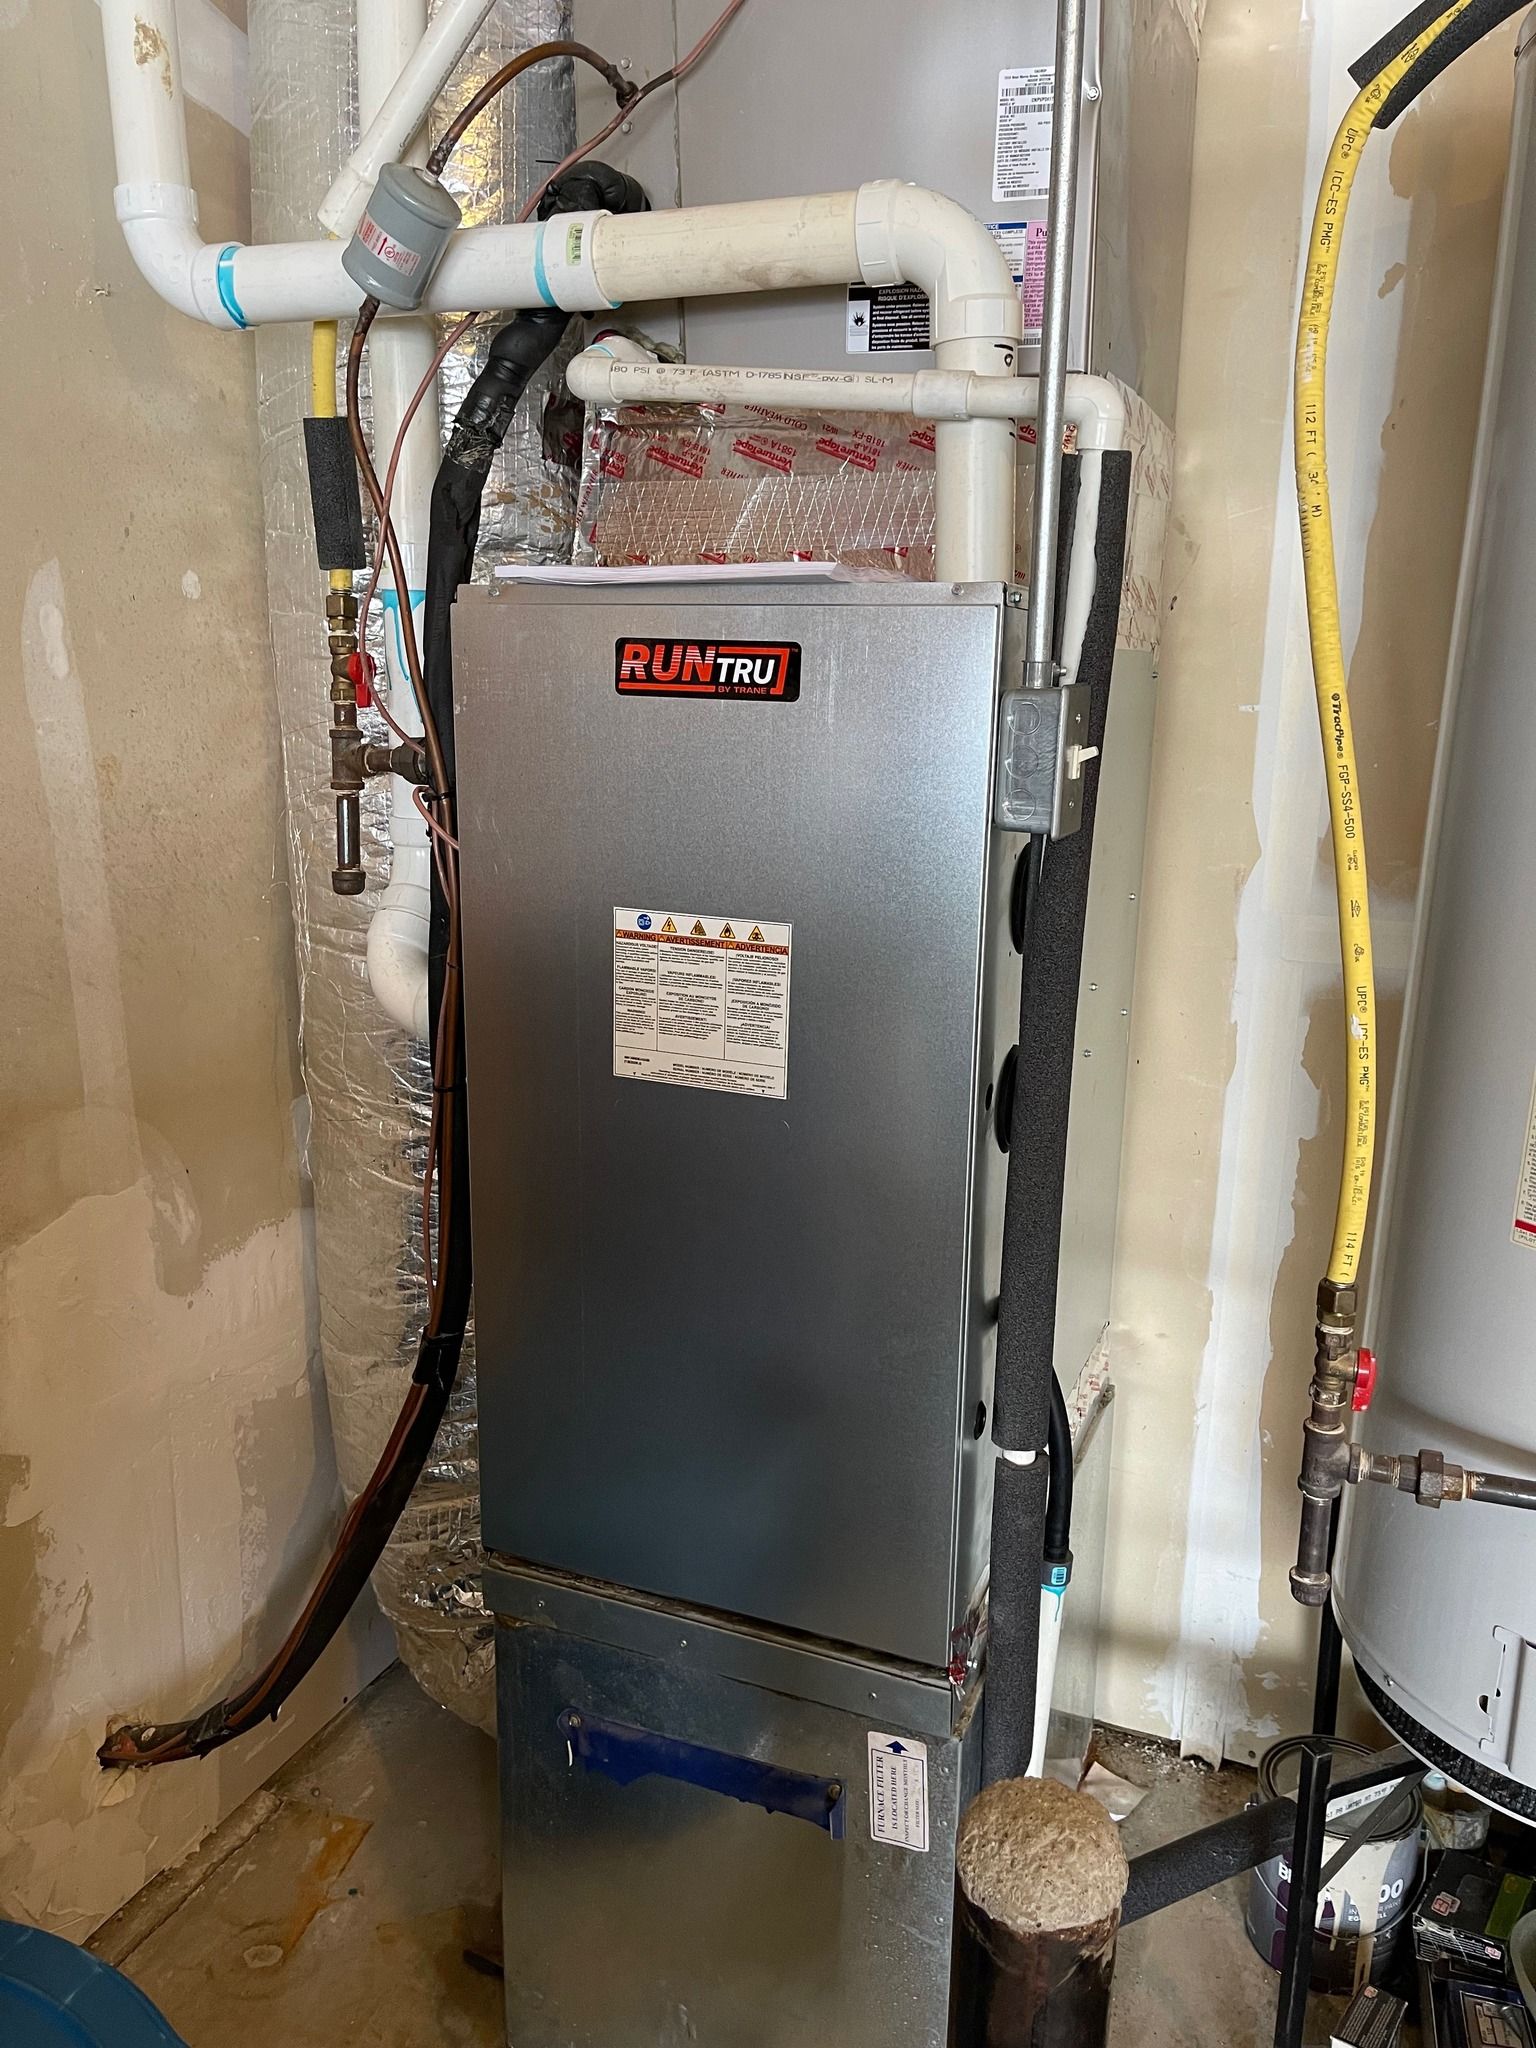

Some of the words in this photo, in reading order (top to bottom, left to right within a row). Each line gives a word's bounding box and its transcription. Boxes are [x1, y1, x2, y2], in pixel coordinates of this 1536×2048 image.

[1325, 170, 1345, 215] ICC-ES
[1036, 227, 1048, 237] Pu
[633, 366, 650, 374] PSI
[702, 369, 740, 378] (ASTM
[745, 370, 782, 379] D-1785
[1305, 403, 1317, 424] 112
[784, 416, 808, 431] COLD
[1305, 430, 1317, 444] FT
[733, 439, 793, 470] VentureTape
[771, 439, 797, 457] 1581A
[816, 436, 877, 467] VentureTape
[576, 509, 584, 527] OLD
[718, 685, 732, 694] BY
[733, 686, 768, 695] TRANE
[1337, 763, 1356, 840] FGP-SS4-500
[622, 930, 657, 941] WARNING
[665, 935, 725, 949] AVERTISSEMENT
[735, 942, 788, 955] ADVERTENCIA
[1344, 1231, 1358, 1249] 114
[1342, 1253, 1354, 1268] FT
[876, 1756, 884, 1788] FILTER
[877, 1790, 885, 1833] FURNACE
[1379, 1878, 1404, 1903] 00
